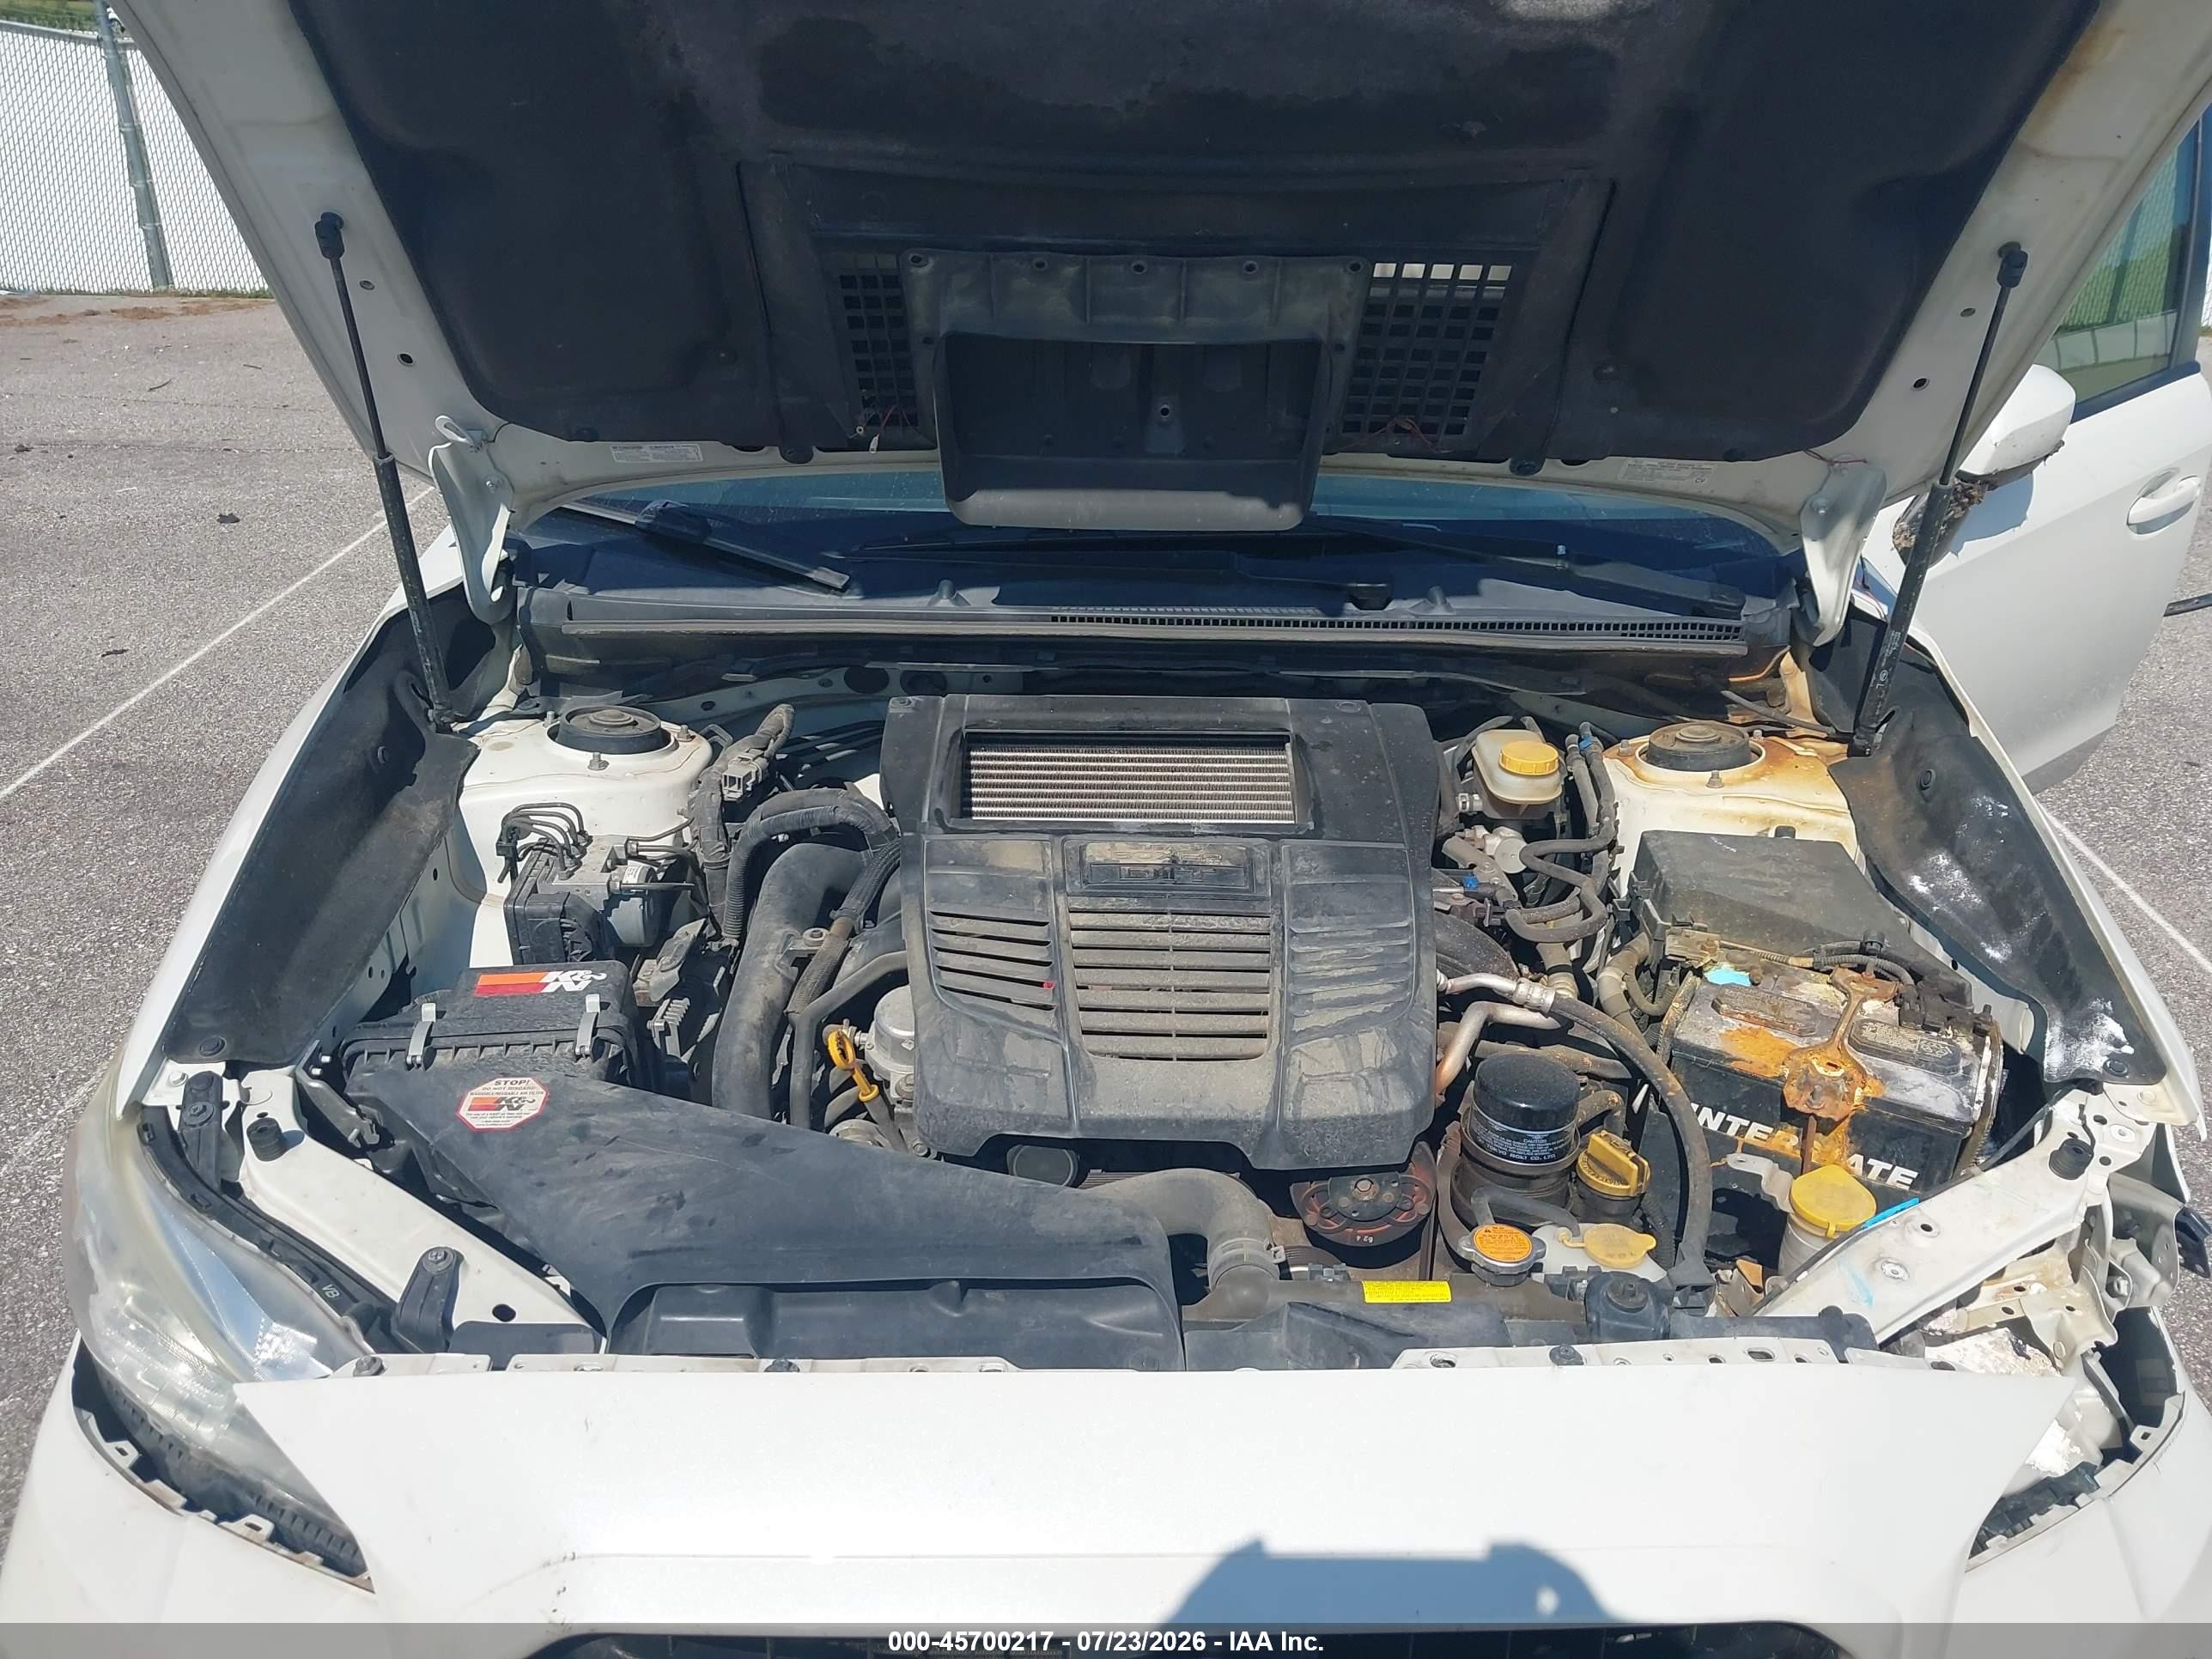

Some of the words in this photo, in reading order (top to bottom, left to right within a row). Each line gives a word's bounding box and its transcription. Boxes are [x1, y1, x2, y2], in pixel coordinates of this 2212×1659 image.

[1113, 851, 1223, 860] BOXER
[539, 969, 608, 994] K&N
[495, 1096, 536, 1111] K&N
[1486, 1144, 1507, 1156] TOKYO
[1690, 1103, 1919, 1191] NTERATE
